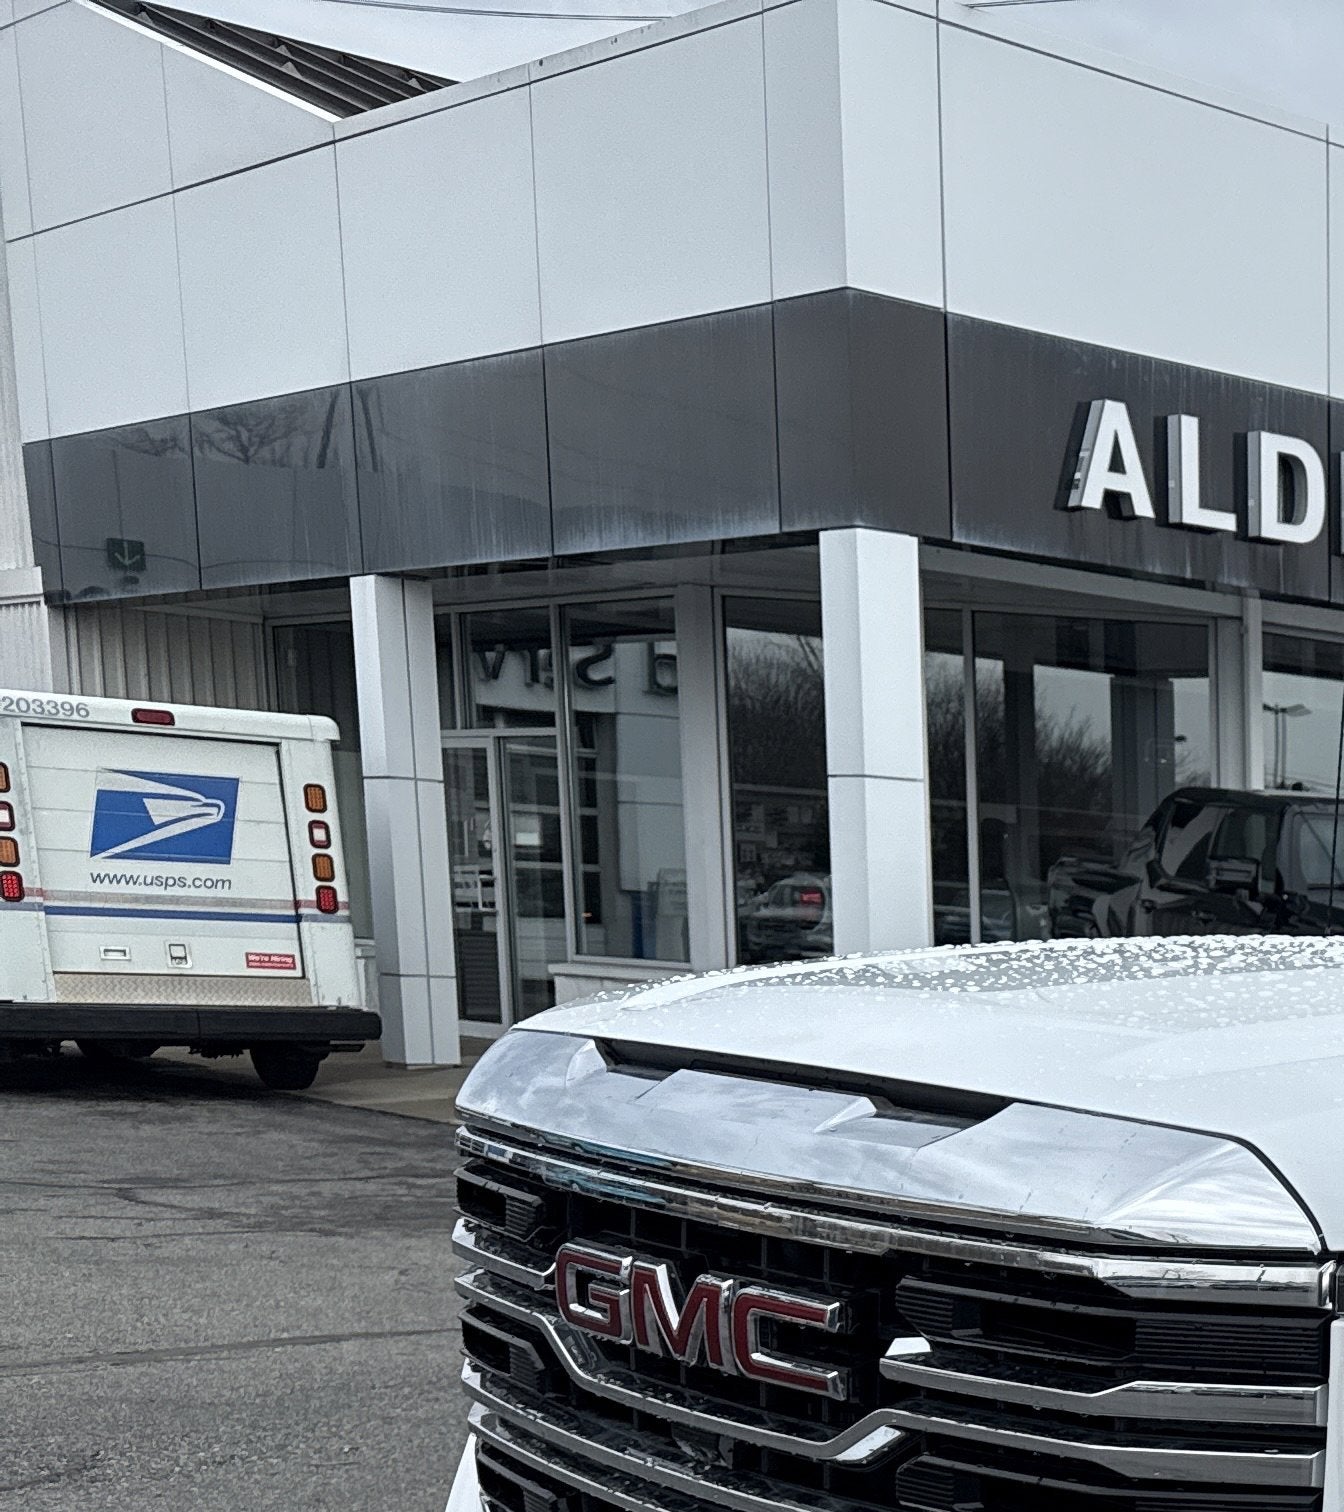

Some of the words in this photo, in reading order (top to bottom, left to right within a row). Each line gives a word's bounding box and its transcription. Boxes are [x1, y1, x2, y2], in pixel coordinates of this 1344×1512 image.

[2, 696, 90, 718] 203396
[90, 872, 232, 890] www.usps.com
[555, 1242, 846, 1400] GMC
